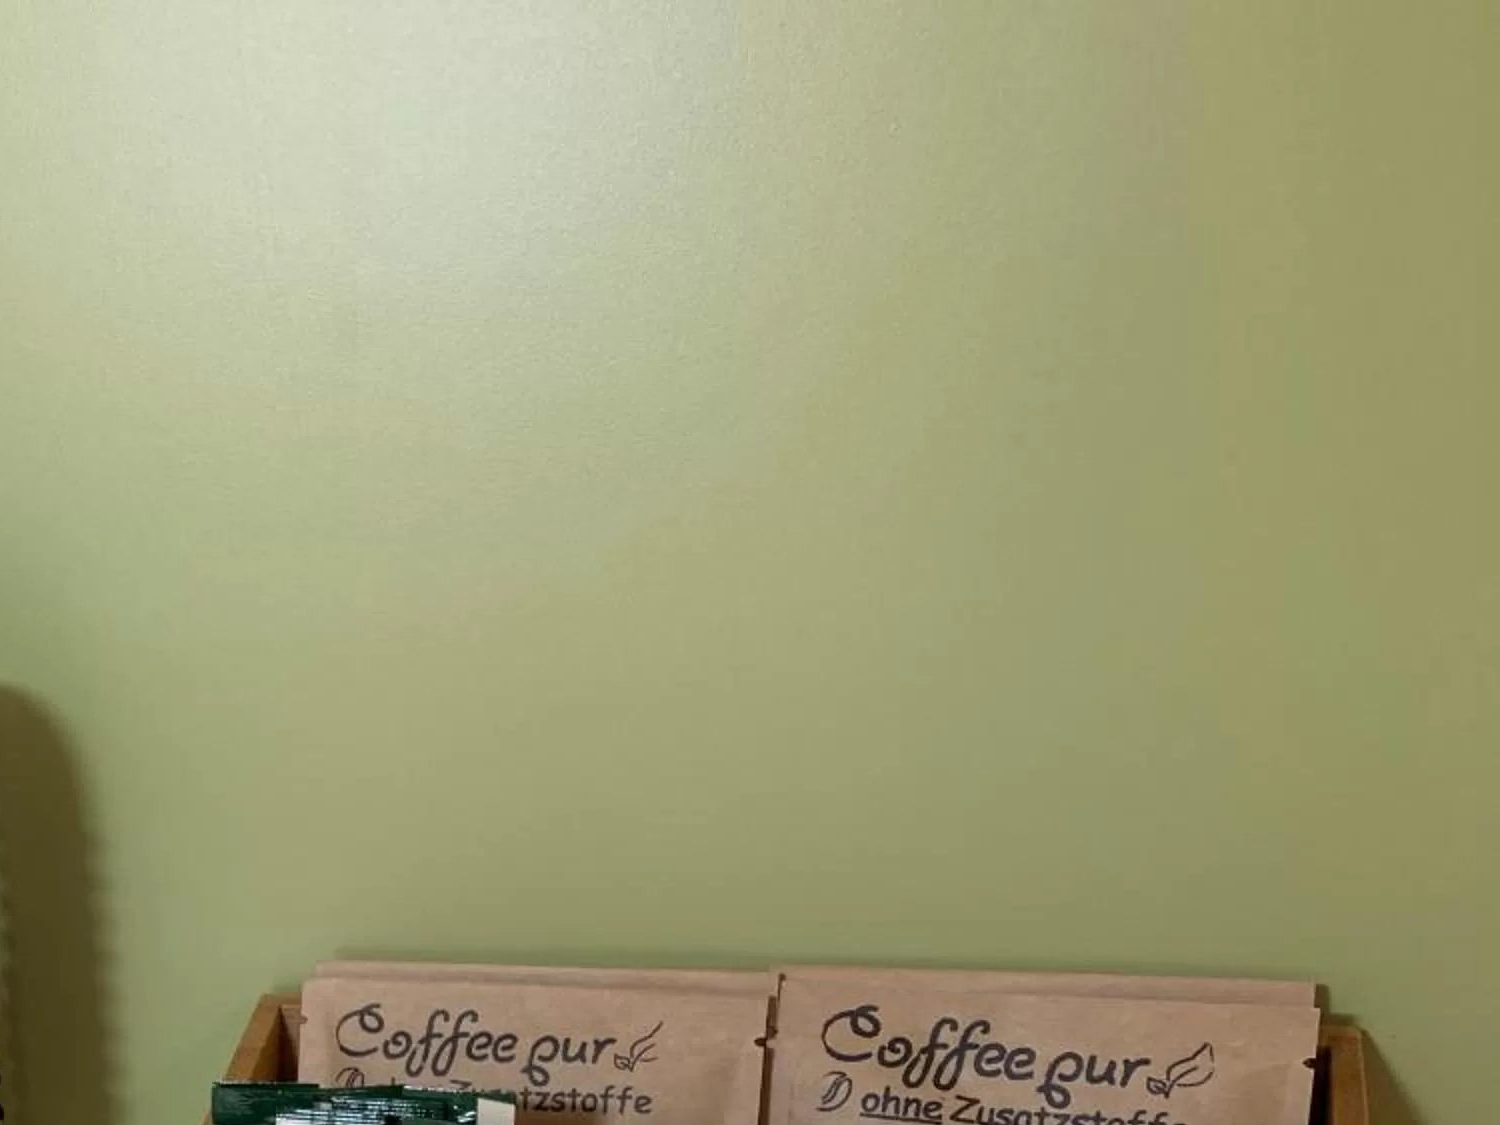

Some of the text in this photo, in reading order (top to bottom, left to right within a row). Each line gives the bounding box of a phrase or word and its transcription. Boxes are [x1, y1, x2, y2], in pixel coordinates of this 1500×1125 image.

[335, 1003, 618, 1087] Coffee pur
[821, 1005, 1151, 1109] Coffee pur
[860, 1086, 943, 1122] ohne
